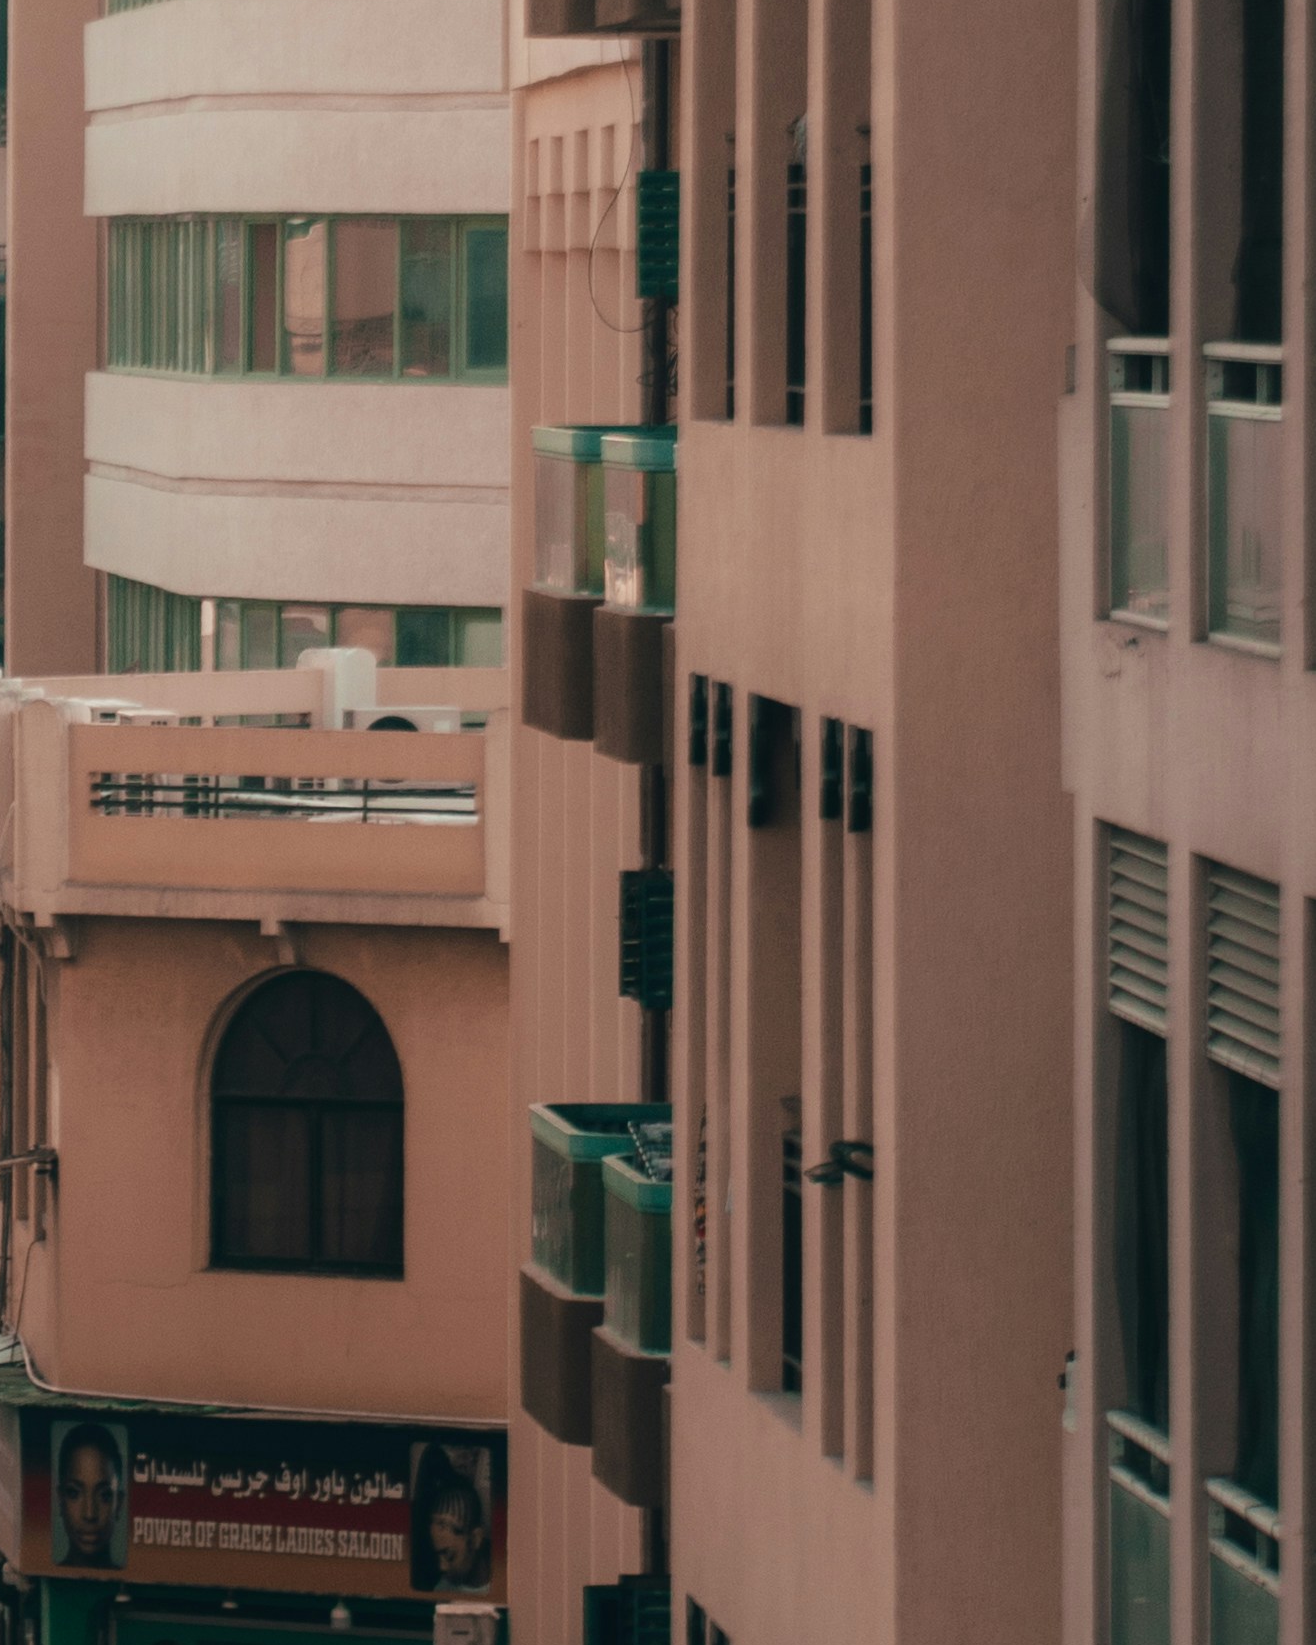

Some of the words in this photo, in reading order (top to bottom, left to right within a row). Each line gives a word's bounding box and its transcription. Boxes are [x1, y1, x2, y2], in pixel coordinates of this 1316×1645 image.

[133, 1453, 207, 1493] للسيدات
[211, 1468, 269, 1499] جريس
[274, 1461, 307, 1500] اوف
[310, 1469, 346, 1504] باور
[350, 1471, 404, 1505] صالون
[133, 1517, 192, 1547] POWER
[195, 1521, 217, 1547] OF
[218, 1522, 272, 1552] GRACE
[275, 1525, 334, 1556] LADIES
[338, 1530, 404, 1561] SALOON
